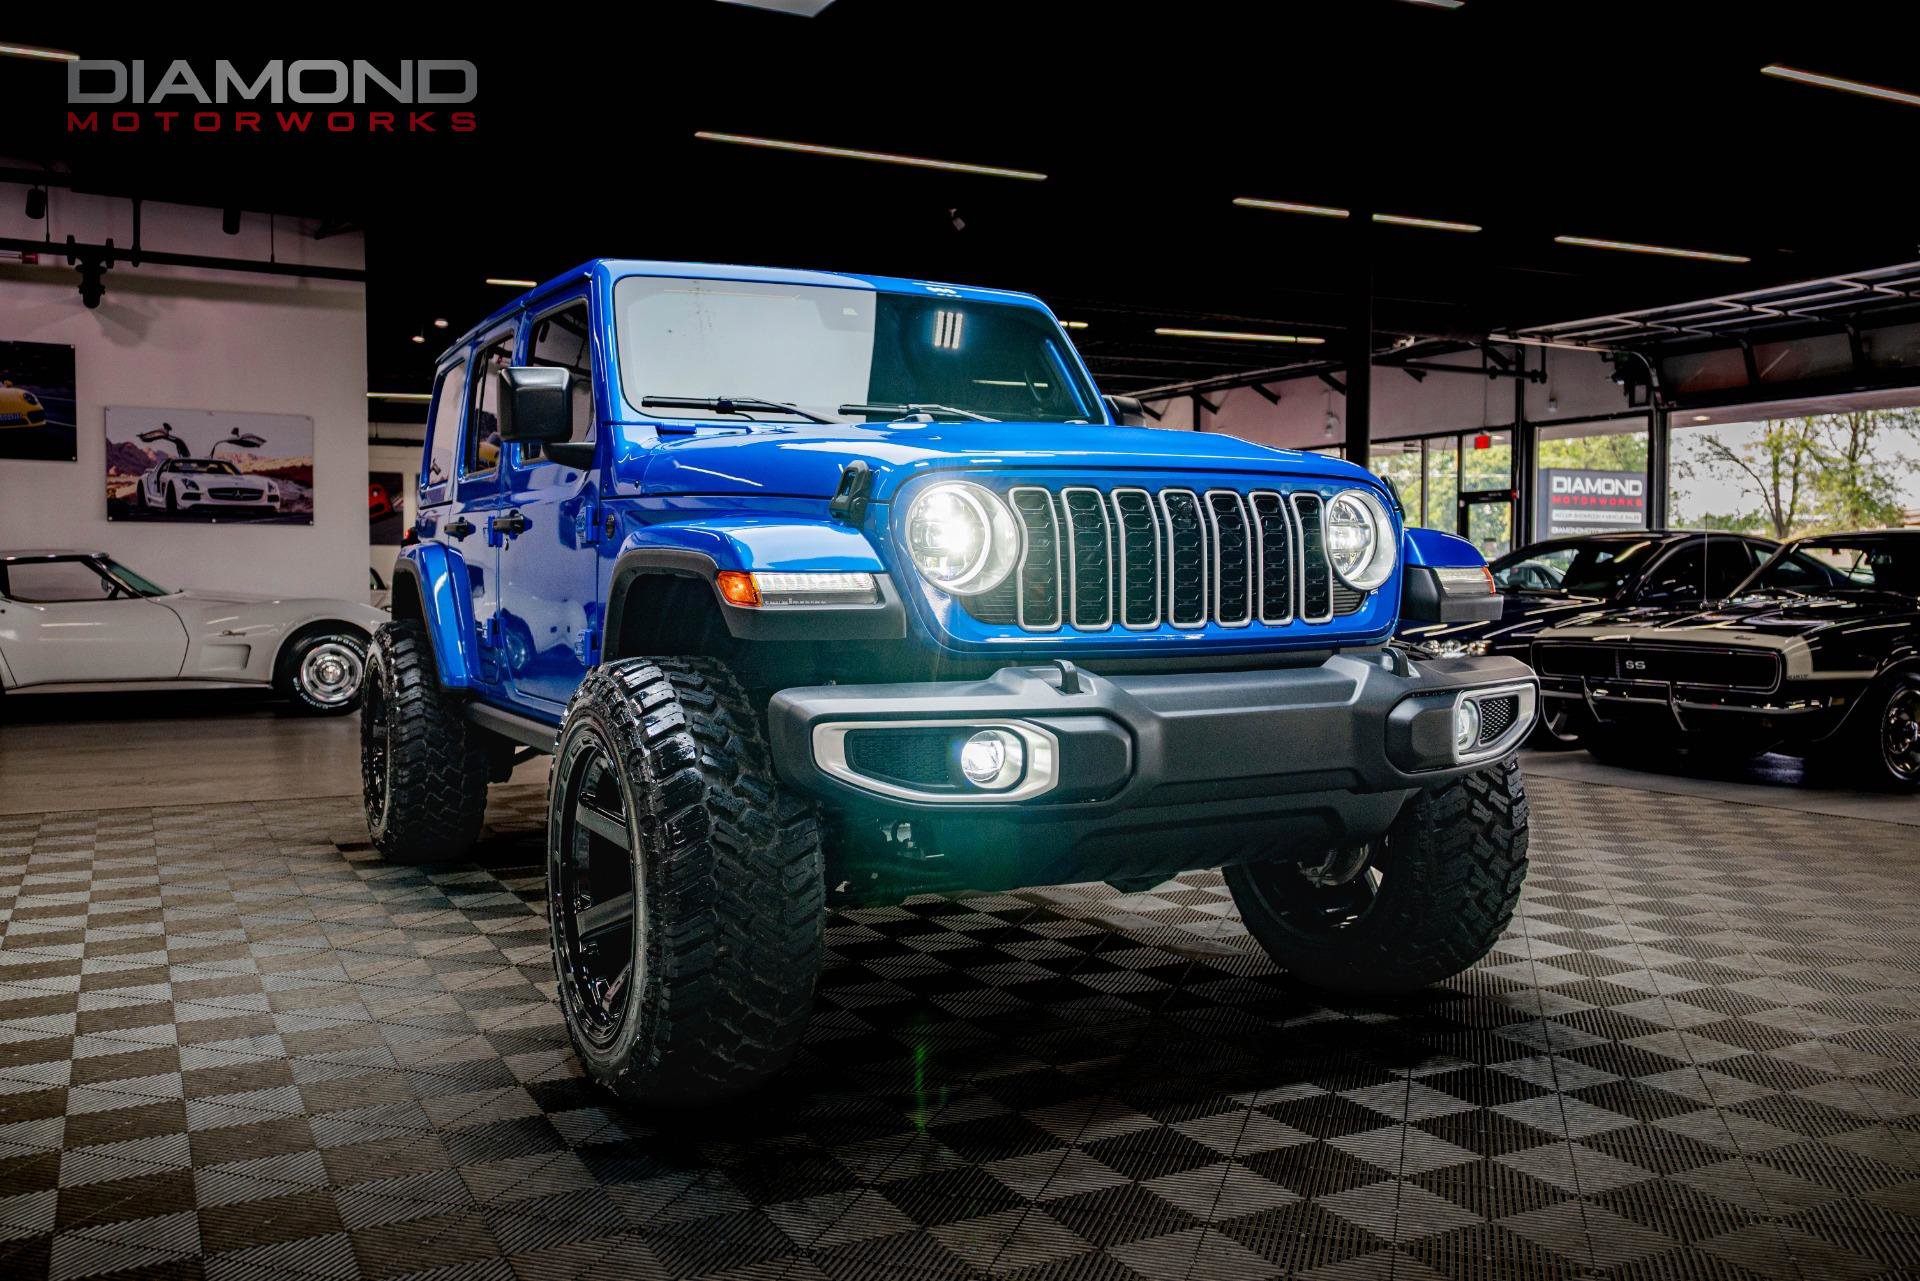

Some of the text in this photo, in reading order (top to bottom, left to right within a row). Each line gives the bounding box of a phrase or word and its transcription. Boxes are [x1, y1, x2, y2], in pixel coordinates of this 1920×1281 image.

[1552, 476, 1643, 496] DIAMOND
[1552, 496, 1643, 508] MOTORWORKS
[1625, 660, 1646, 669] SS
